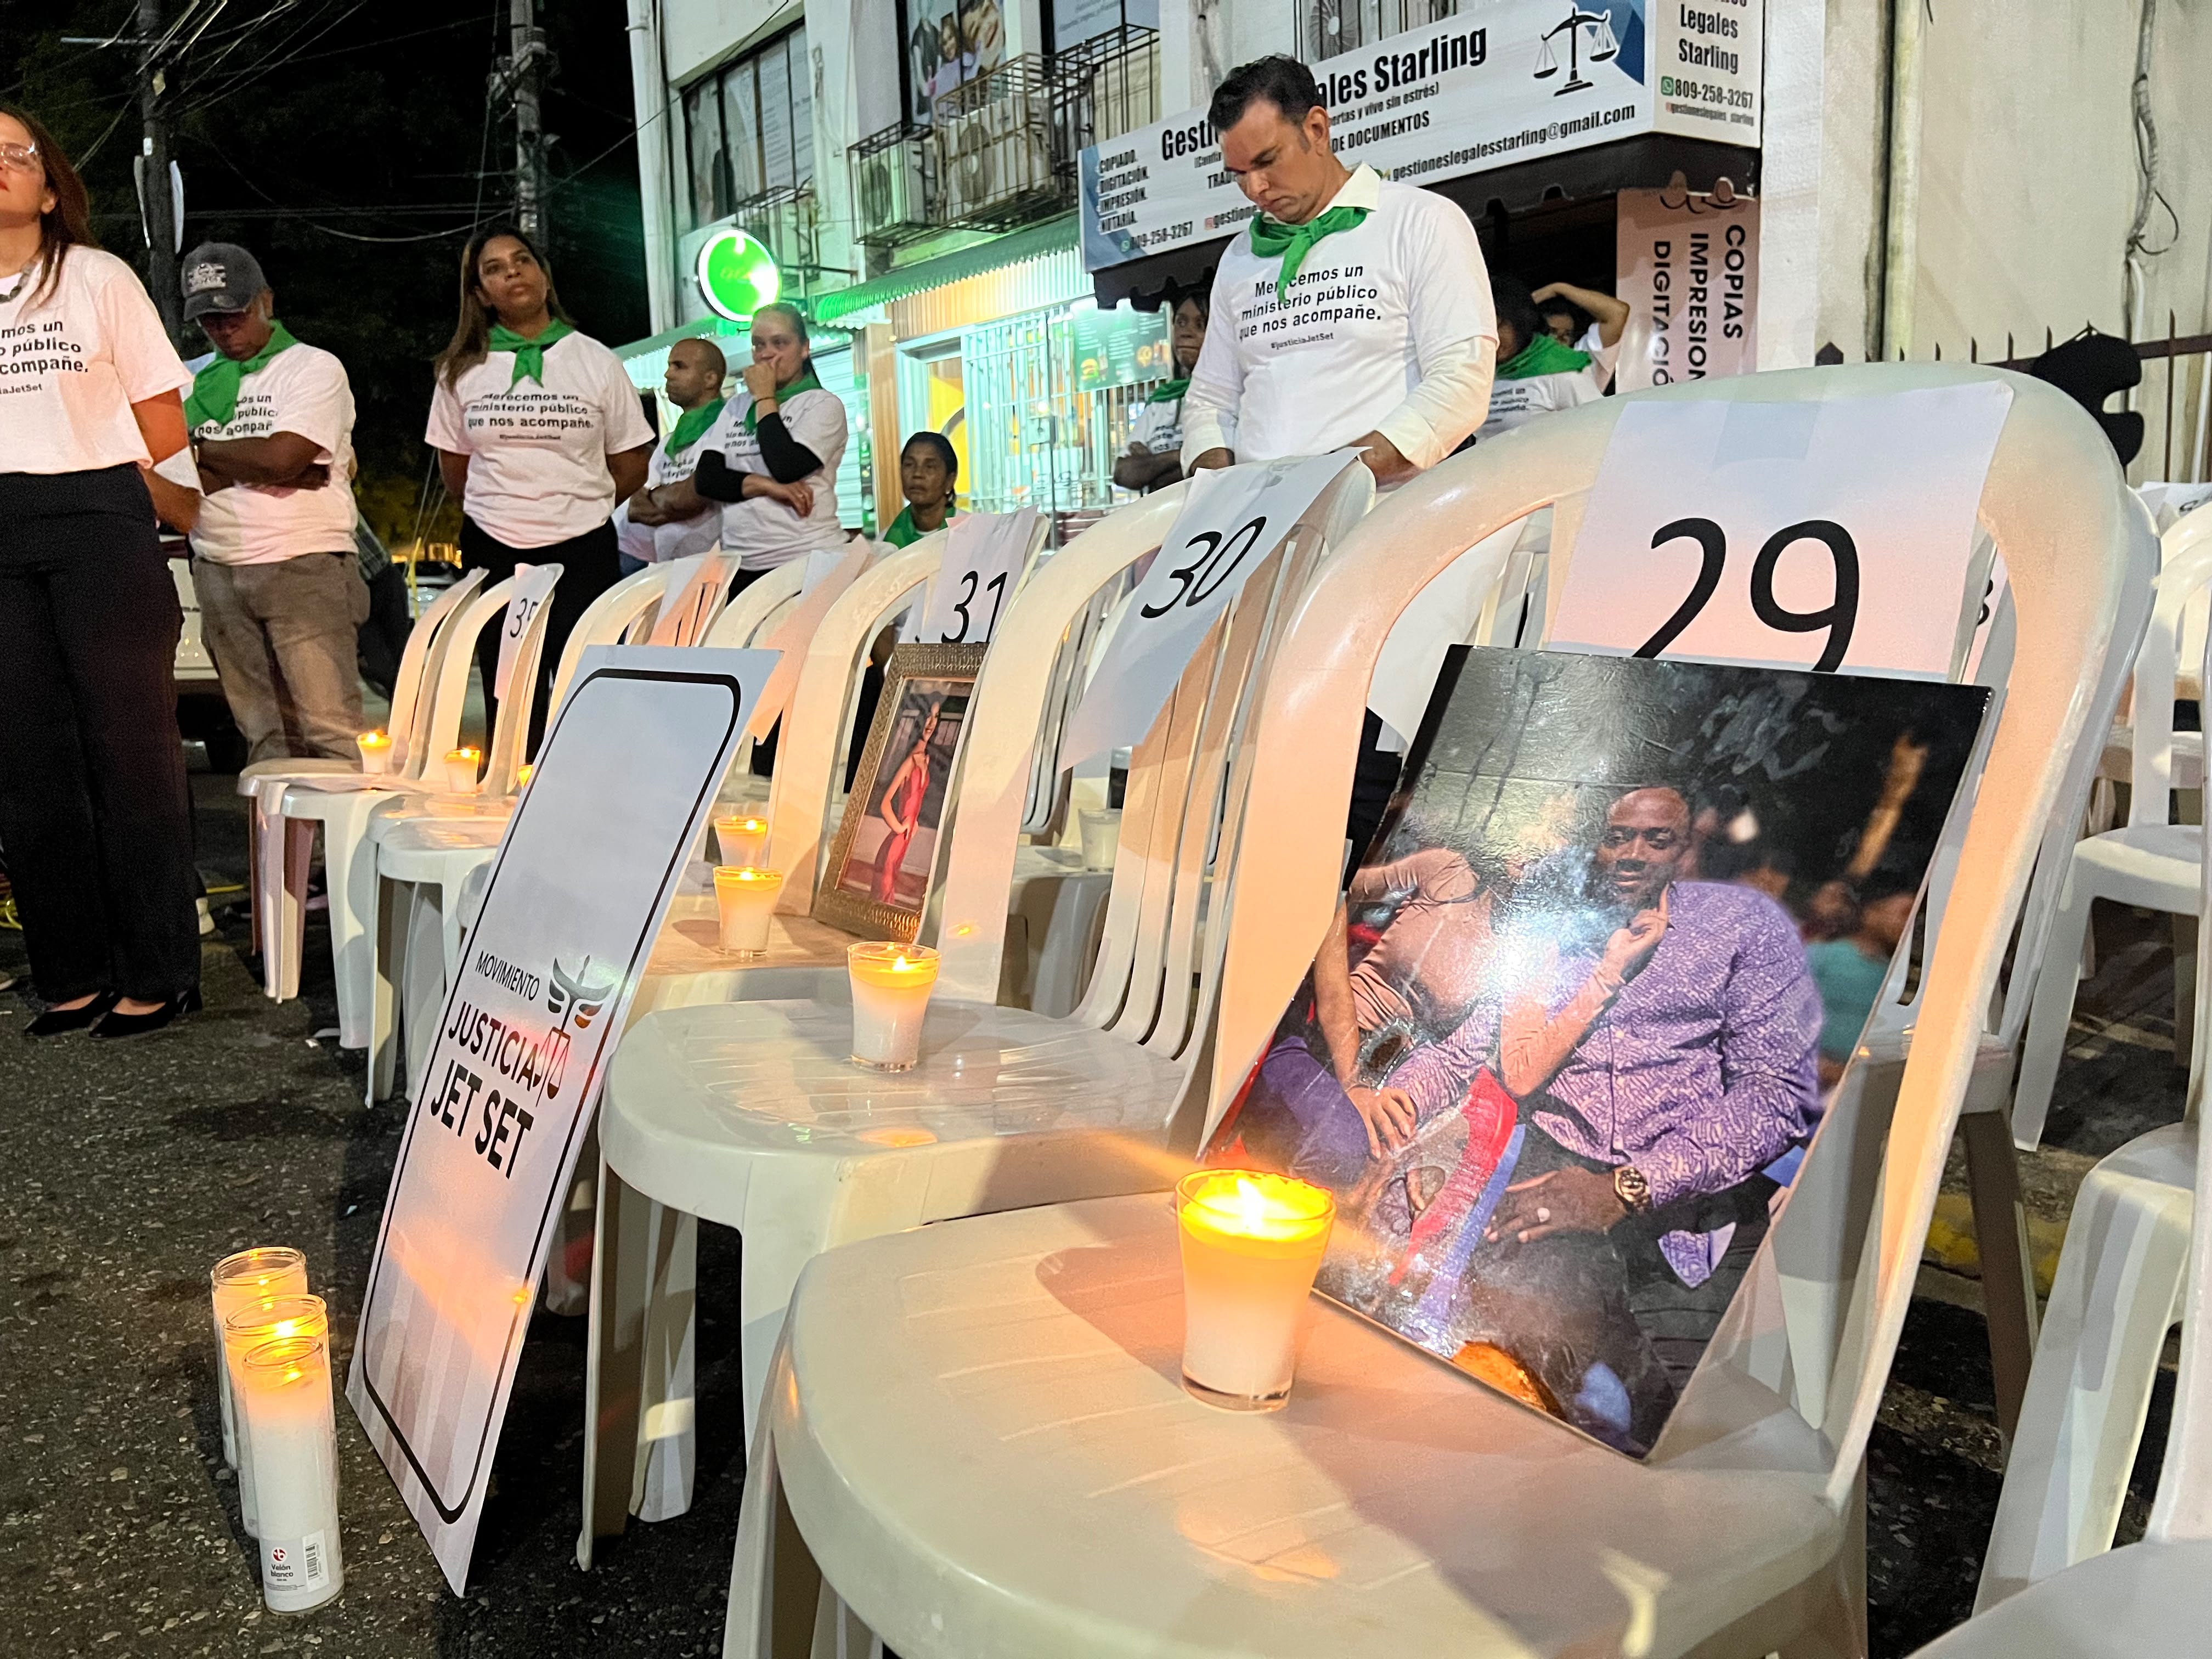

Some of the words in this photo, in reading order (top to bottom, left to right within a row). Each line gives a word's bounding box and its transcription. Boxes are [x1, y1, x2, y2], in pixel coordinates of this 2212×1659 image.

[1680, 4, 1738, 38] Legales
[1679, 38, 1738, 75] Starling
[1162, 120, 1219, 161] Gesti
[1316, 70, 1367, 108] ales
[1374, 27, 1486, 92] Starling
[1386, 96, 1401, 110] sin
[1675, 79, 1753, 109] 809-258-3267
[1332, 136, 1345, 153] DE
[1348, 110, 1430, 149] DOCUMENTOS
[1393, 104, 1635, 182] gestioneslegalesstarling@gmail.com
[1255, 268, 1339, 297] Mercemos
[1345, 266, 1364, 278] un
[1724, 225, 1746, 338] COPIAS
[1242, 292, 1311, 321] ministerio
[1317, 285, 1378, 306] público
[1262, 317, 1287, 334] nos
[1293, 304, 1381, 324] acompañe.
[1652, 241, 1674, 386] DIGITACIÓ
[43, 321, 64, 332] un
[0, 356, 88, 375] compañe.
[13, 336, 81, 358] público
[489, 417, 514, 427] nos
[1141, 516, 1267, 619] 30
[941, 571, 1008, 644] 31
[1631, 517, 1860, 674] 29
[475, 950, 540, 1001] MOVIMIENTO
[448, 1001, 539, 1092] JUSTICIA
[431, 1058, 483, 1138] JET
[475, 1089, 534, 1180] SET
